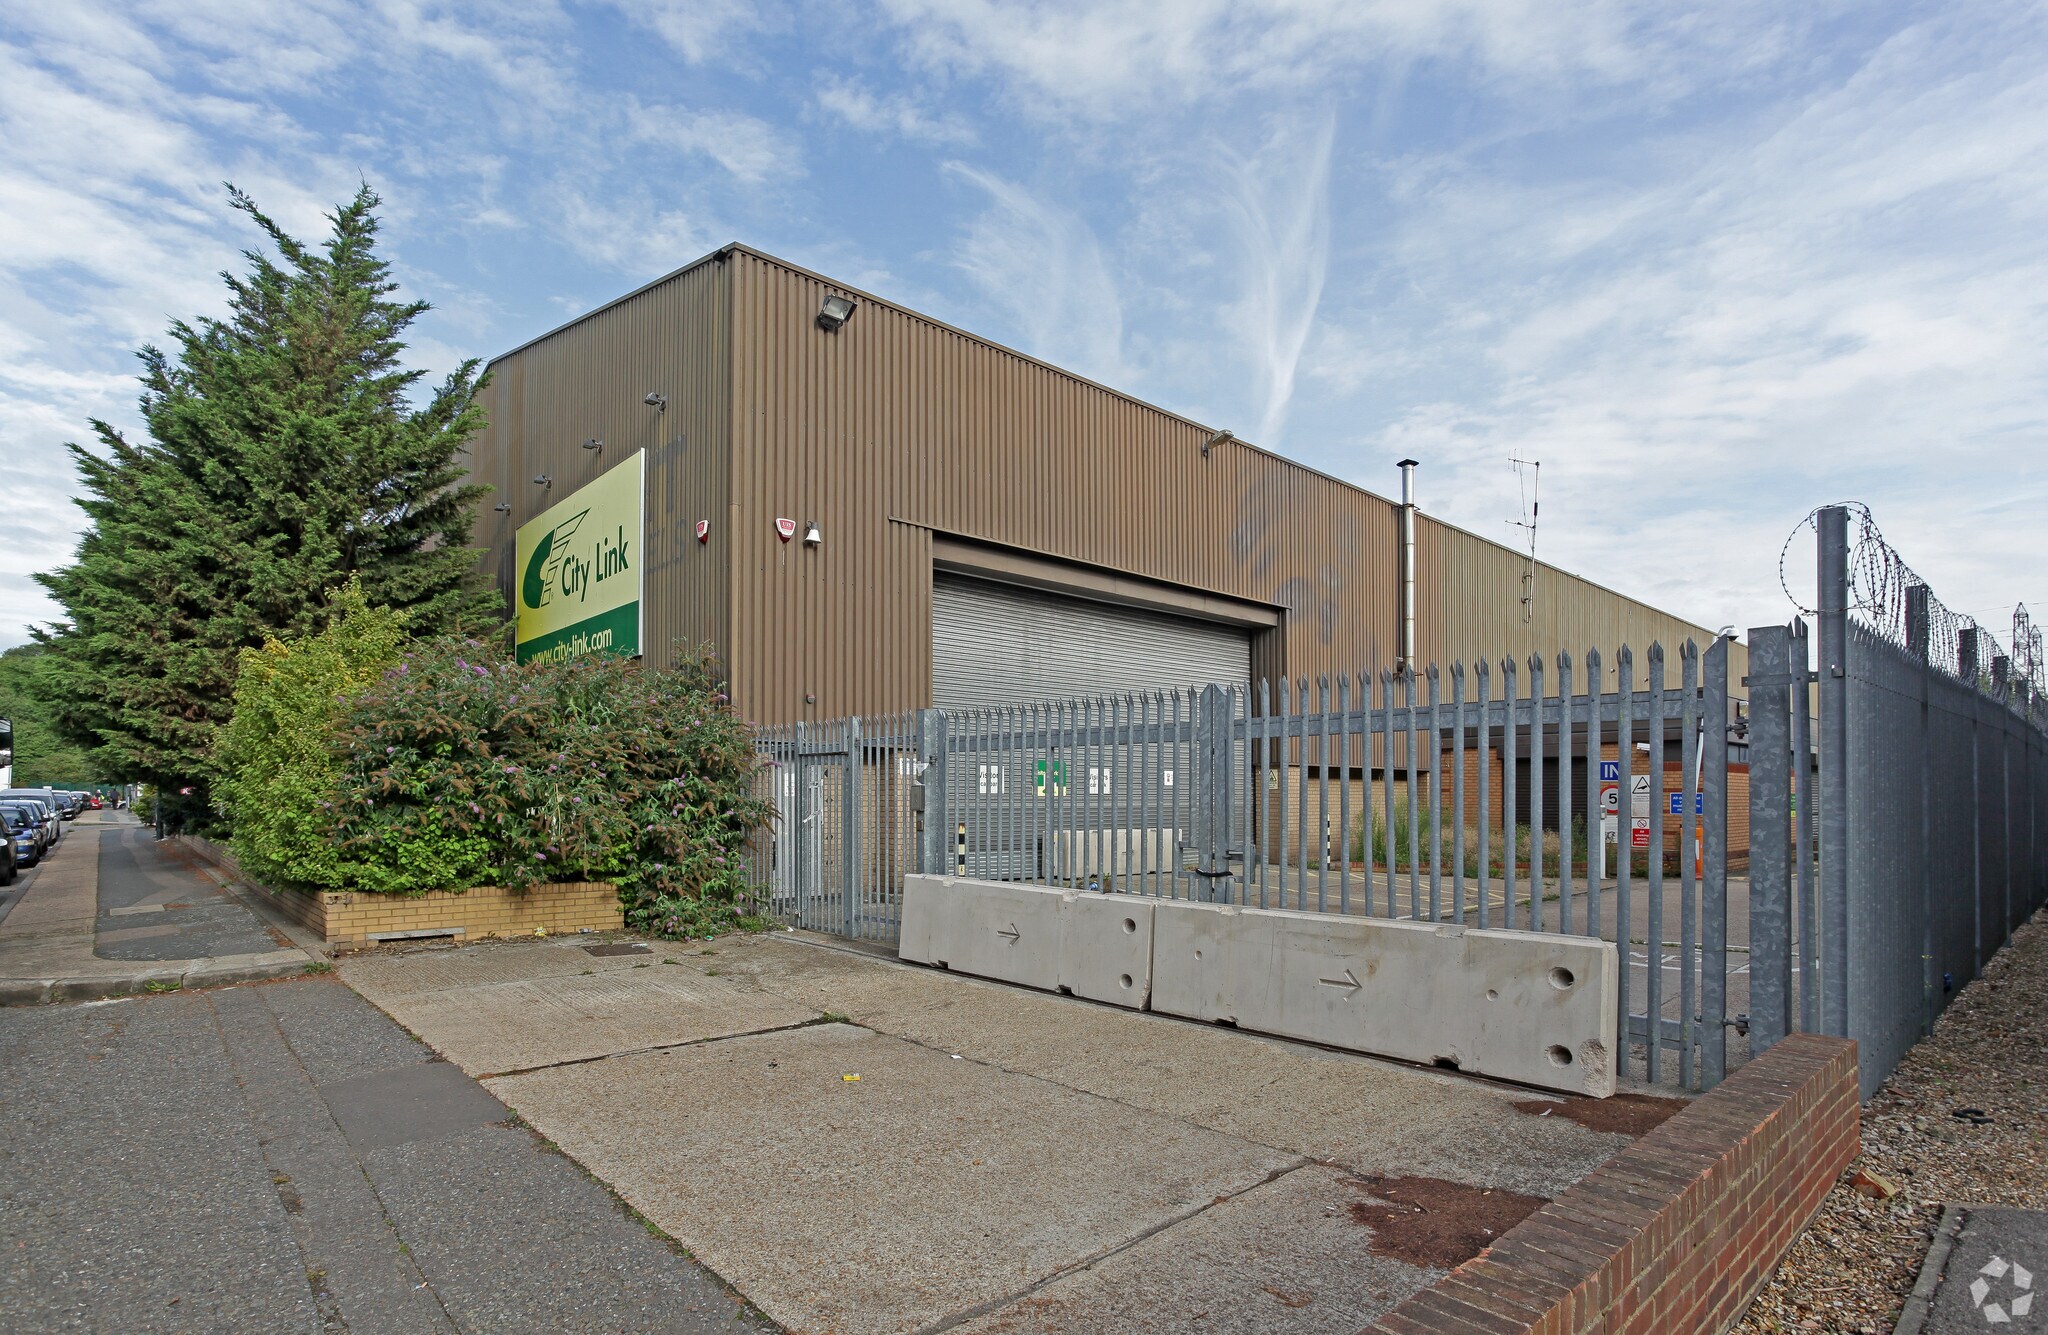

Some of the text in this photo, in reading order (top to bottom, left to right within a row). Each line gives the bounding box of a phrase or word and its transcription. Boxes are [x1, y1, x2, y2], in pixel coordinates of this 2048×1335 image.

[562, 525, 629, 603] City Link
[1608, 793, 1618, 804] 5
